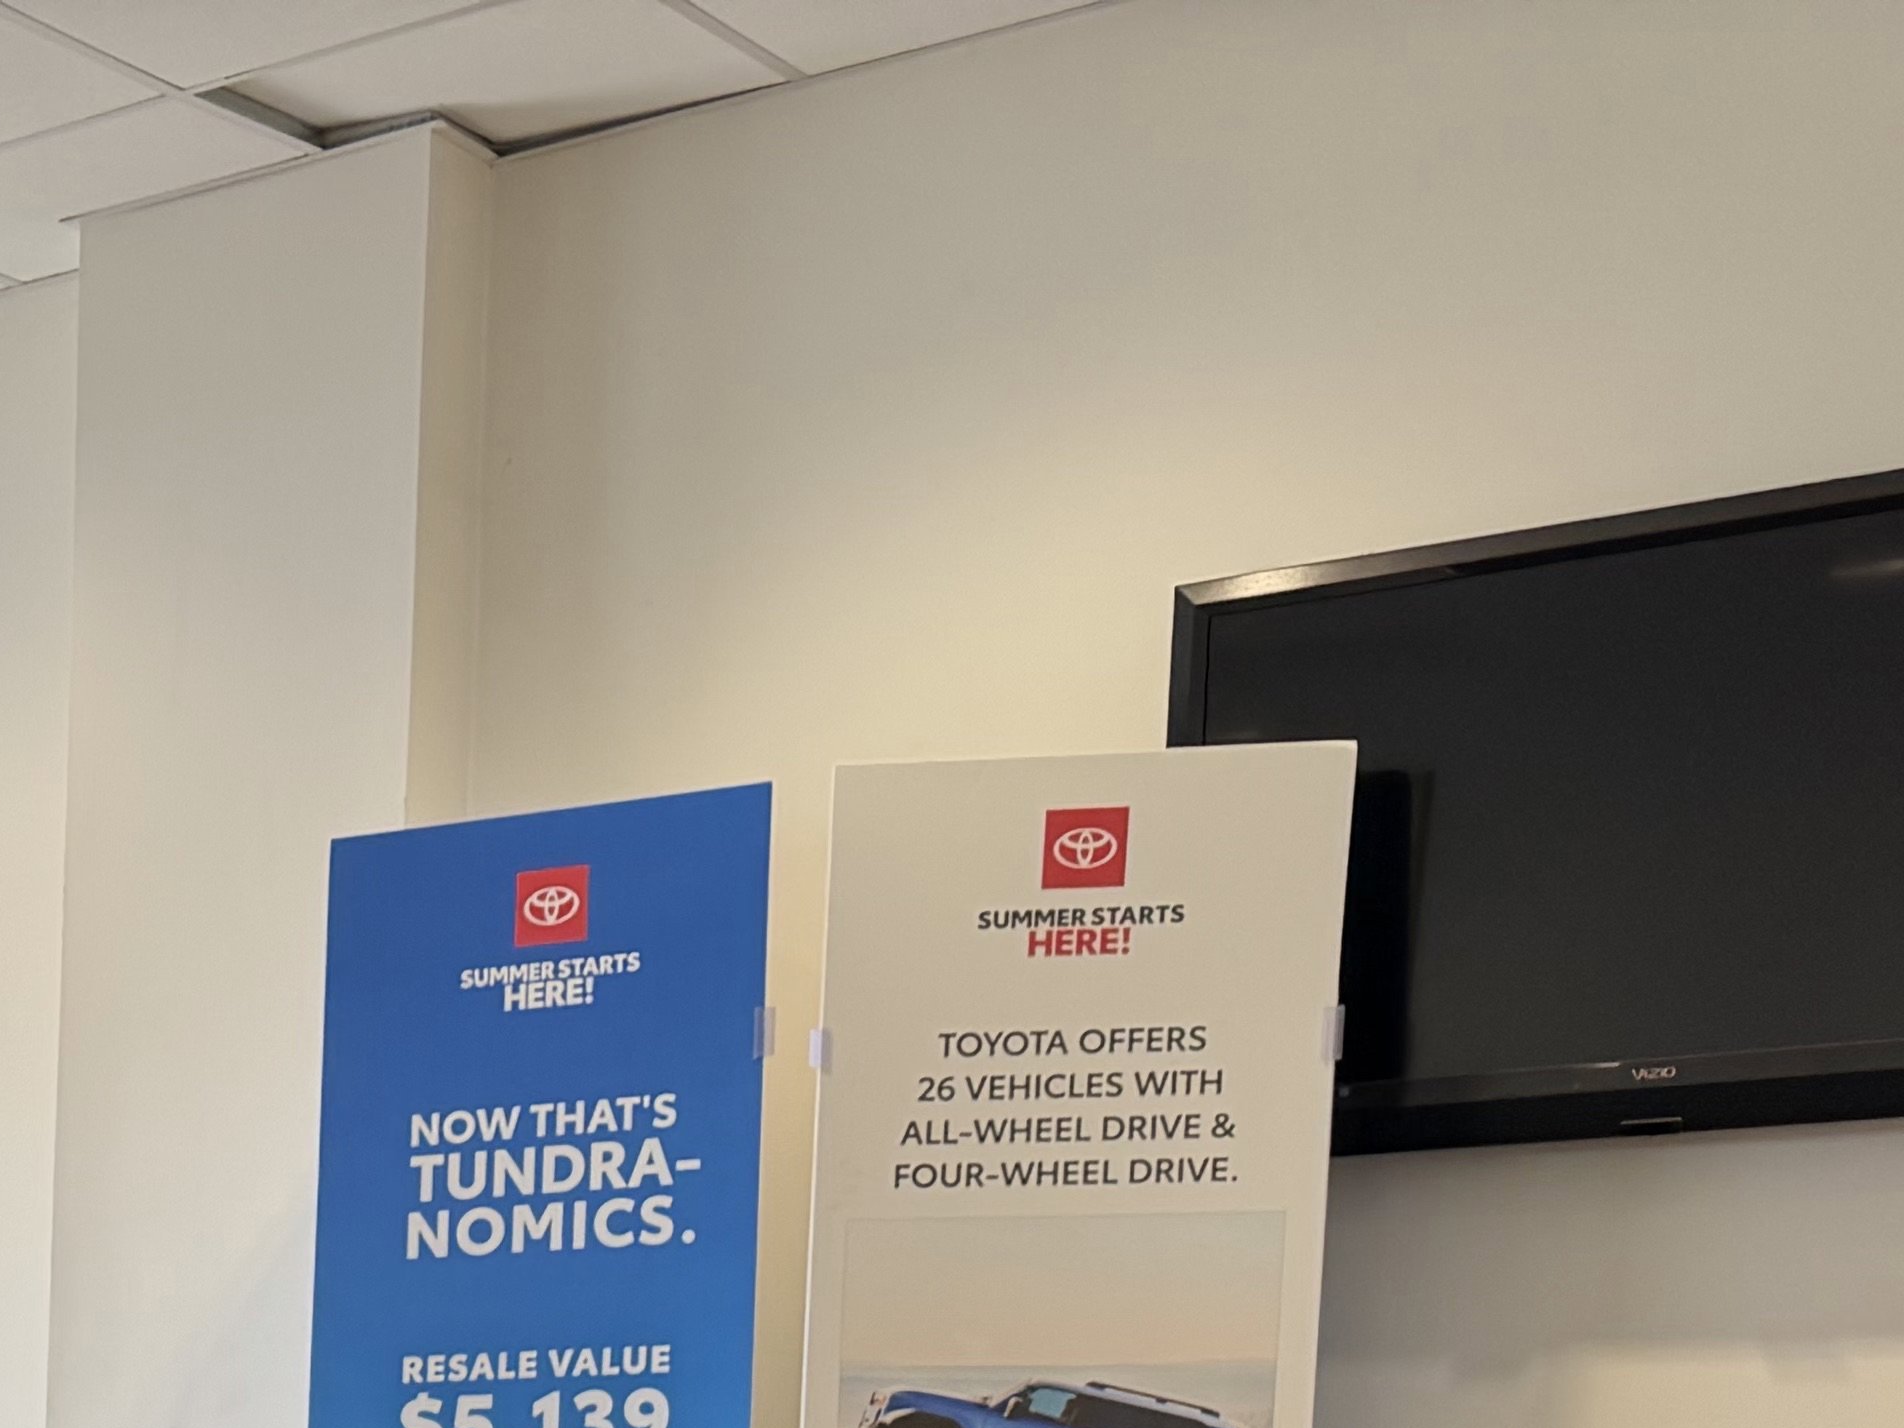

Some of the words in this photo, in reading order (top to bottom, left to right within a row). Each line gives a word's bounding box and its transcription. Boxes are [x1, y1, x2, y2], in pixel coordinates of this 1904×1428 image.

[978, 907, 1087, 930] SUMMER
[1090, 903, 1185, 926] STARTS
[1026, 926, 1131, 958] HERE!
[459, 961, 555, 990] SUMMER
[558, 951, 641, 980] STARTS
[502, 976, 594, 1012] HERE!
[938, 1029, 1069, 1059] TOYOTA
[1078, 1025, 1208, 1055] OFFERS
[917, 1075, 956, 1103] 26
[964, 1071, 1124, 1102] VEHICLES
[1134, 1069, 1223, 1097] WITH
[409, 1105, 522, 1149] NOW
[528, 1092, 678, 1139] THAT'S
[900, 1116, 1092, 1147] ALL-WHEEL
[1101, 1113, 1201, 1142] DRIVE
[1210, 1112, 1236, 1139] &
[409, 1136, 702, 1203] TUNDRA-
[893, 1160, 1119, 1190] FOUR-WHEEL
[1128, 1156, 1239, 1184] DRIVE.
[405, 1195, 696, 1261] NOMICS.
[401, 1350, 538, 1385] RESALE
[547, 1343, 672, 1378] VALUE
